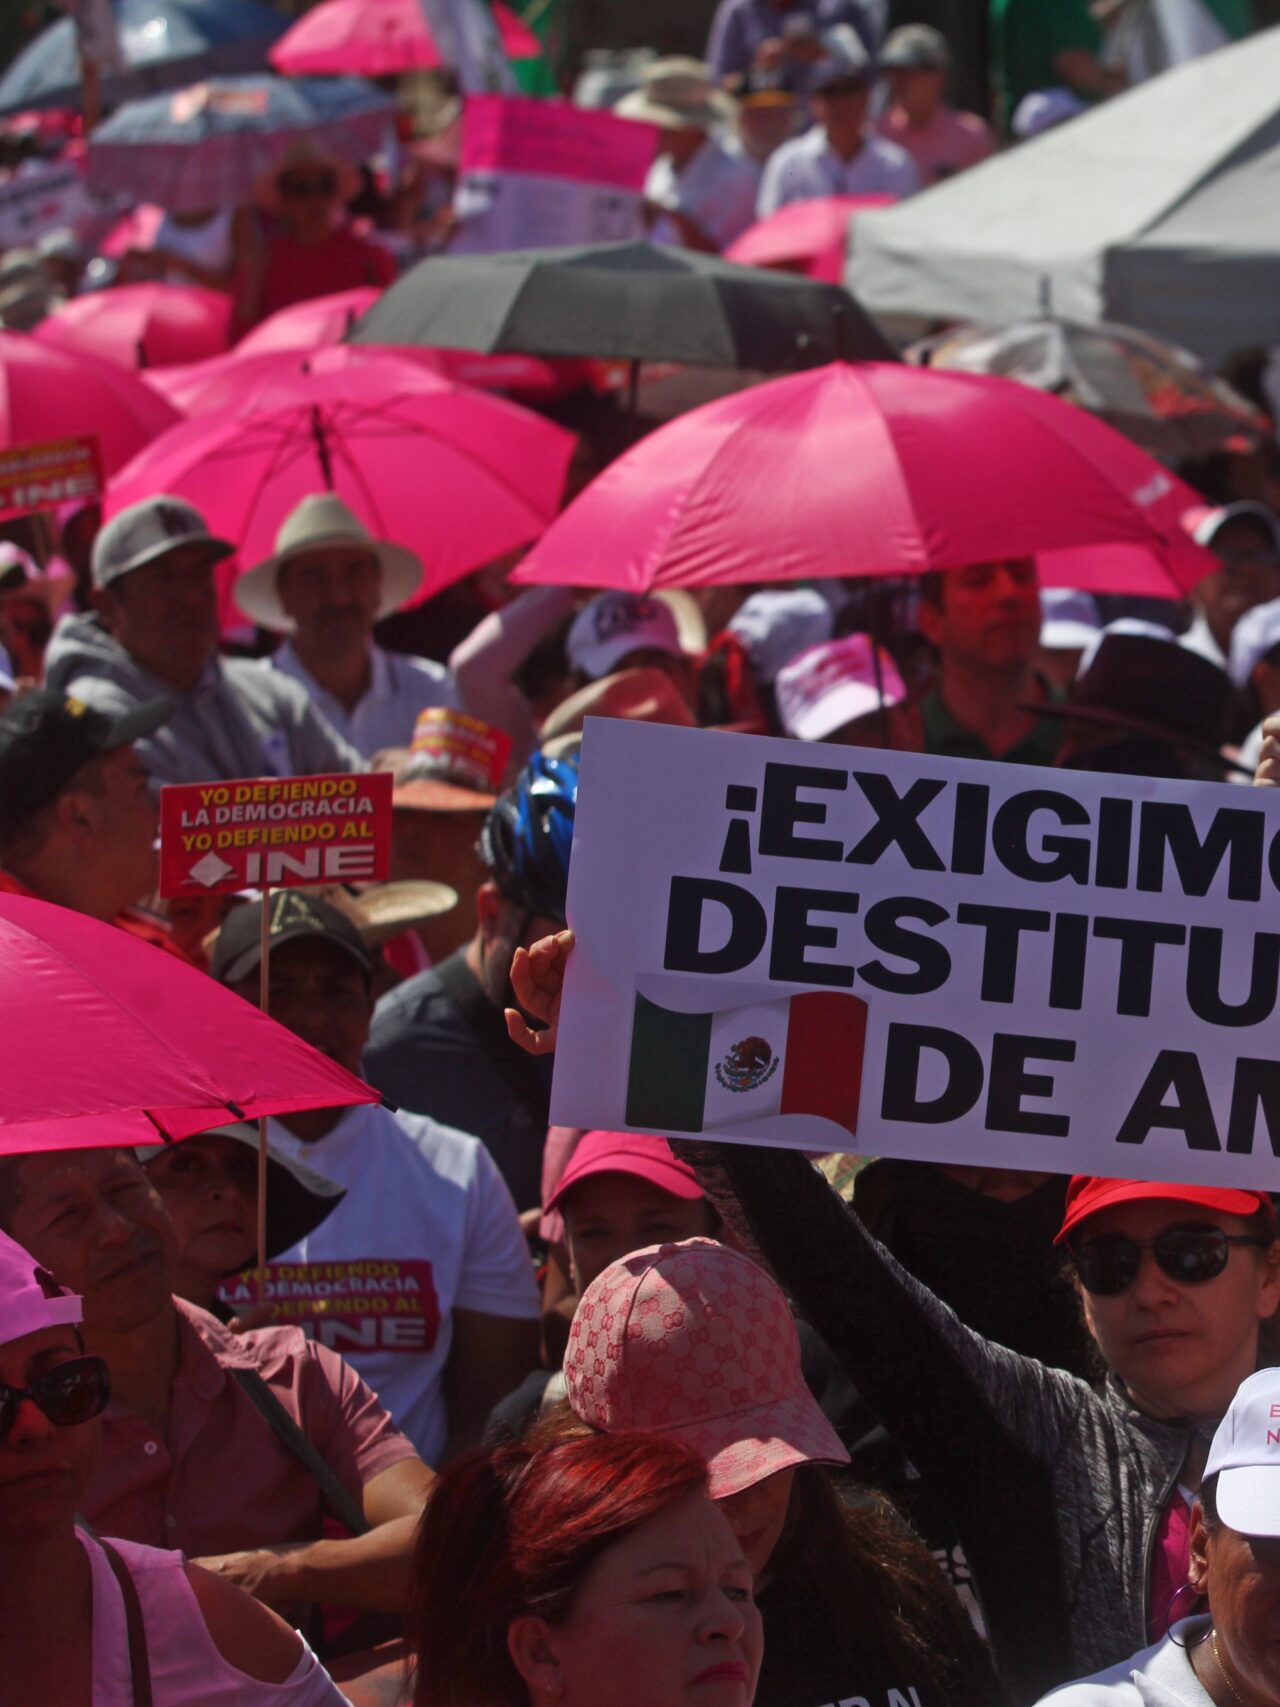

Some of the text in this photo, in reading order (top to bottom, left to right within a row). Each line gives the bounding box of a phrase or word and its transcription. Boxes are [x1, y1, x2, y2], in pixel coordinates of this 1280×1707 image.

[200, 779, 357, 807] YO DEFIENDO
[181, 797, 374, 828] LA DEMOCRACIA
[182, 820, 374, 853] YO DEFIENDO AL
[246, 844, 376, 883] INE
[881, 1022, 1077, 1138] DE
[279, 1261, 400, 1281] DEFIENDO
[219, 1284, 251, 1301] LA
[395, 1295, 423, 1312] AL
